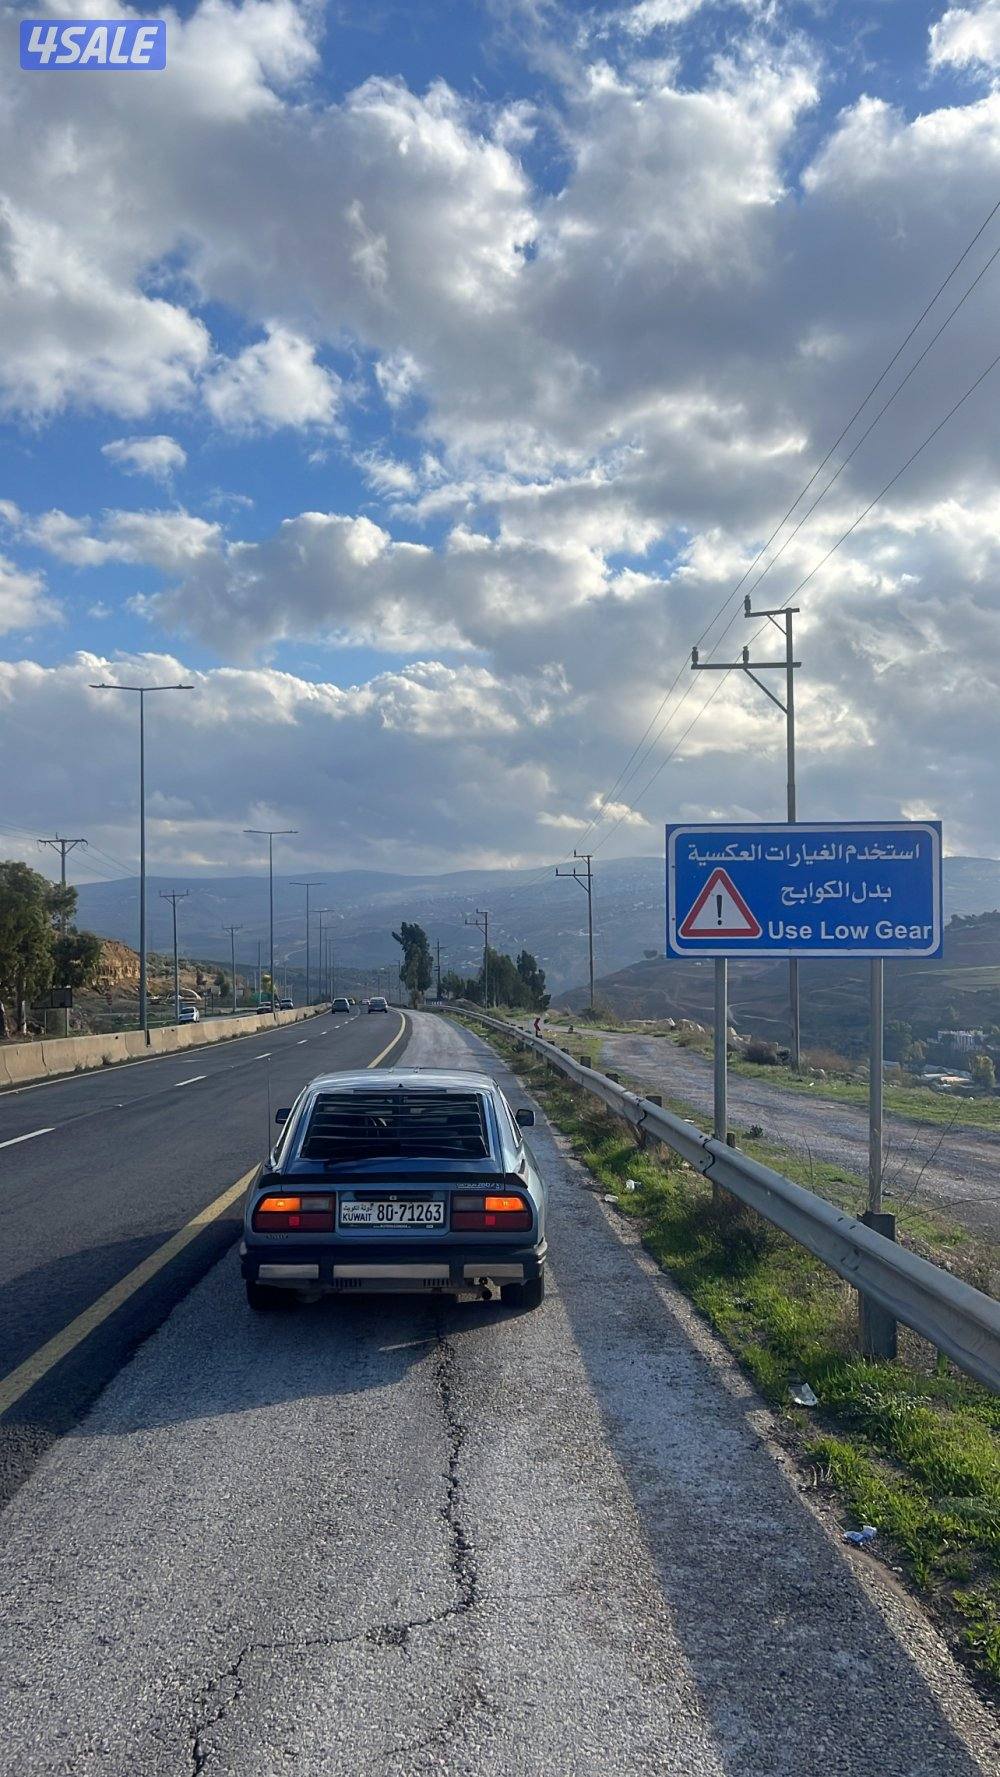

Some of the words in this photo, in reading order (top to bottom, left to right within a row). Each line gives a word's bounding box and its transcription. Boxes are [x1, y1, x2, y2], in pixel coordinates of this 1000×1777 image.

[687, 843, 762, 867] العكسية
[764, 843, 843, 867] الغيارات
[845, 843, 920, 864] استخدم
[780, 880, 849, 906] الكوابح
[852, 879, 892, 904] بدل
[768, 920, 812, 940] Use
[820, 921, 869, 940] Low
[875, 920, 932, 940] Gear
[342, 1212, 372, 1222] KUWAIT
[377, 1203, 442, 1222] 80-71263
